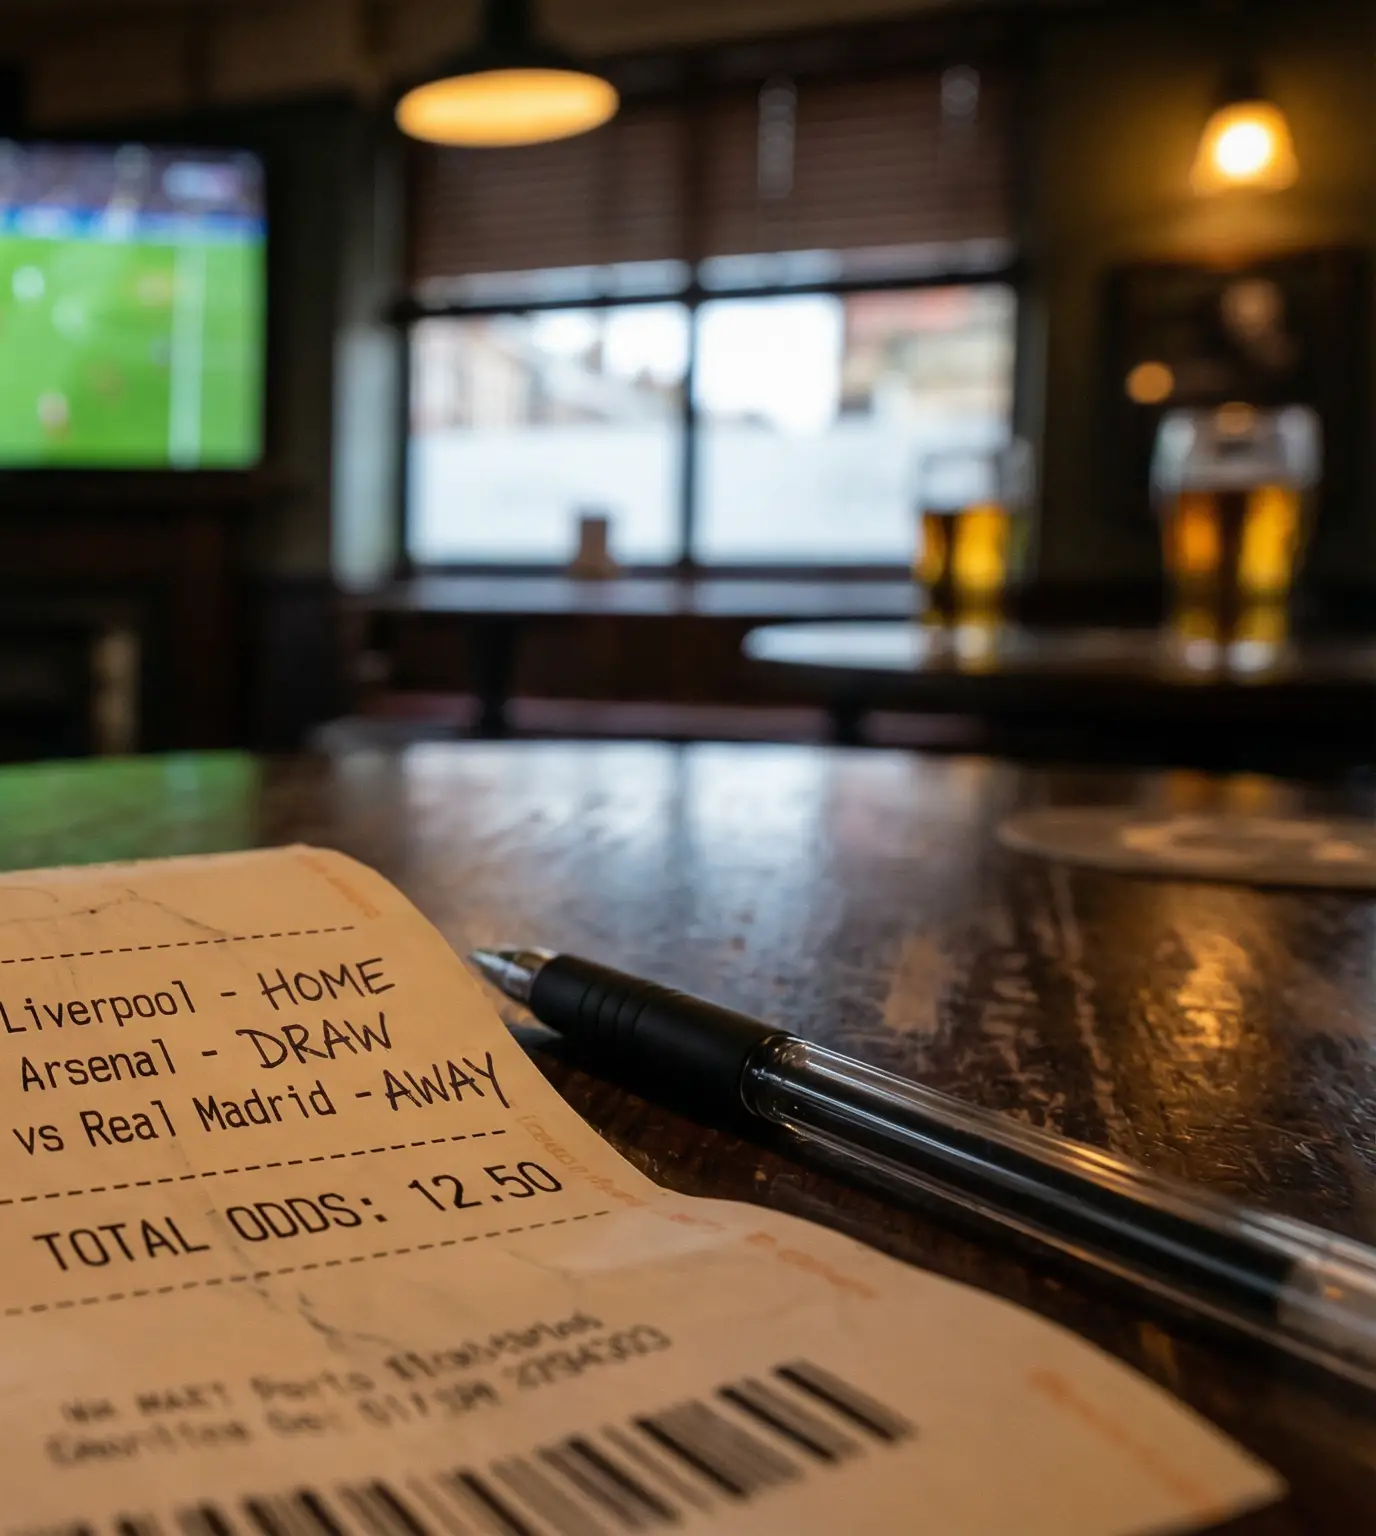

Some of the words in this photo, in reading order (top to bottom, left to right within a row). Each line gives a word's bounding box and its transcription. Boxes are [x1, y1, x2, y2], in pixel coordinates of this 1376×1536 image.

[256, 957, 396, 1011] HOME
[21, 1038, 176, 1093] Arsenal
[234, 1011, 392, 1069] DRAW
[12, 1124, 65, 1156] vs
[79, 1099, 177, 1148] Real
[191, 1079, 337, 1133] Madrid
[382, 1051, 511, 1112] AWAY
[32, 1216, 211, 1272] TOTAL
[225, 1192, 388, 1243] ODDS:
[407, 1161, 563, 1212] 12.50
